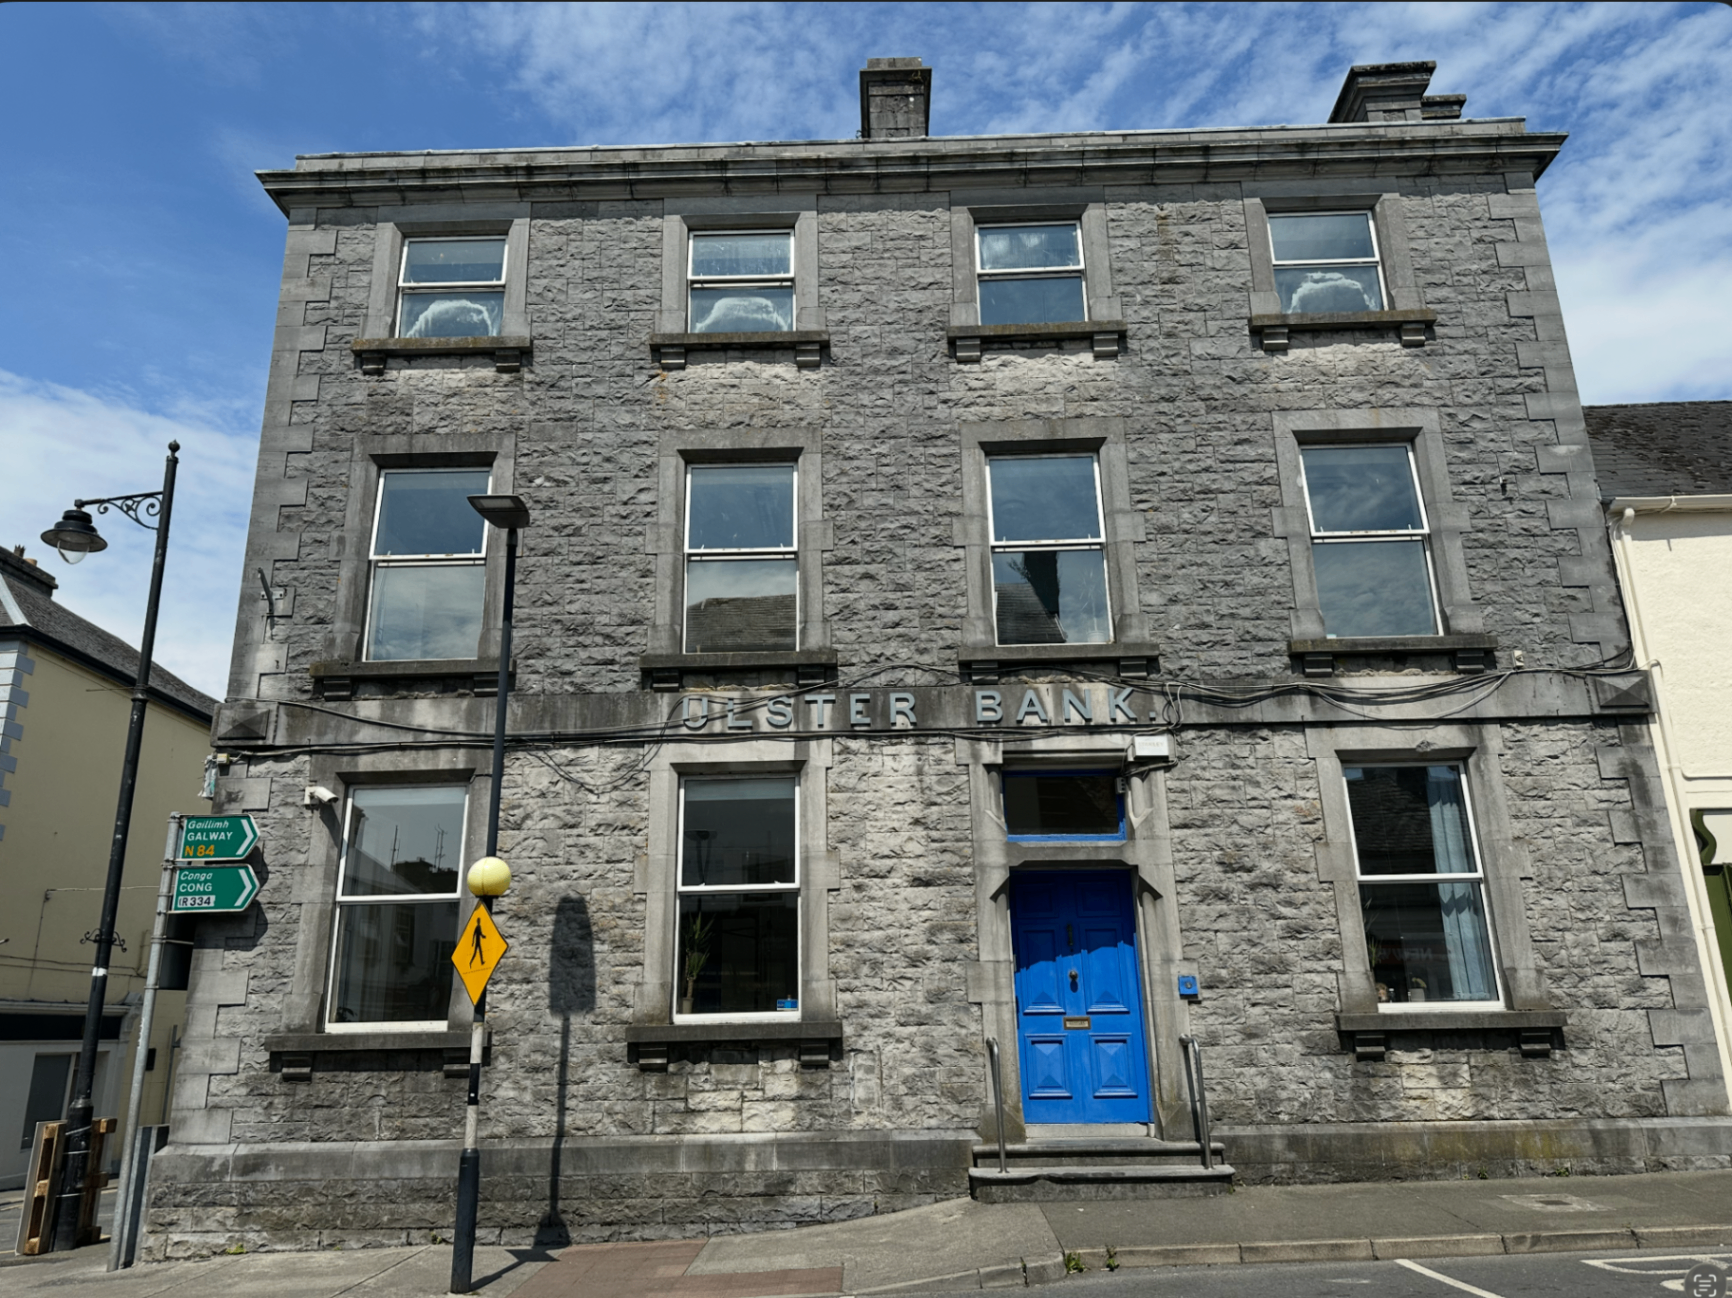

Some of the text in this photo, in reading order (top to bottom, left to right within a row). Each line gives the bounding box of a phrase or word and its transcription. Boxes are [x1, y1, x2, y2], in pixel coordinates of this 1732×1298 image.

[682, 690, 917, 729] ULSTER
[188, 820, 229, 829] Gaillimh
[187, 832, 233, 841] GALWAY
[180, 871, 213, 882] Conga
[179, 883, 213, 892] CONG
